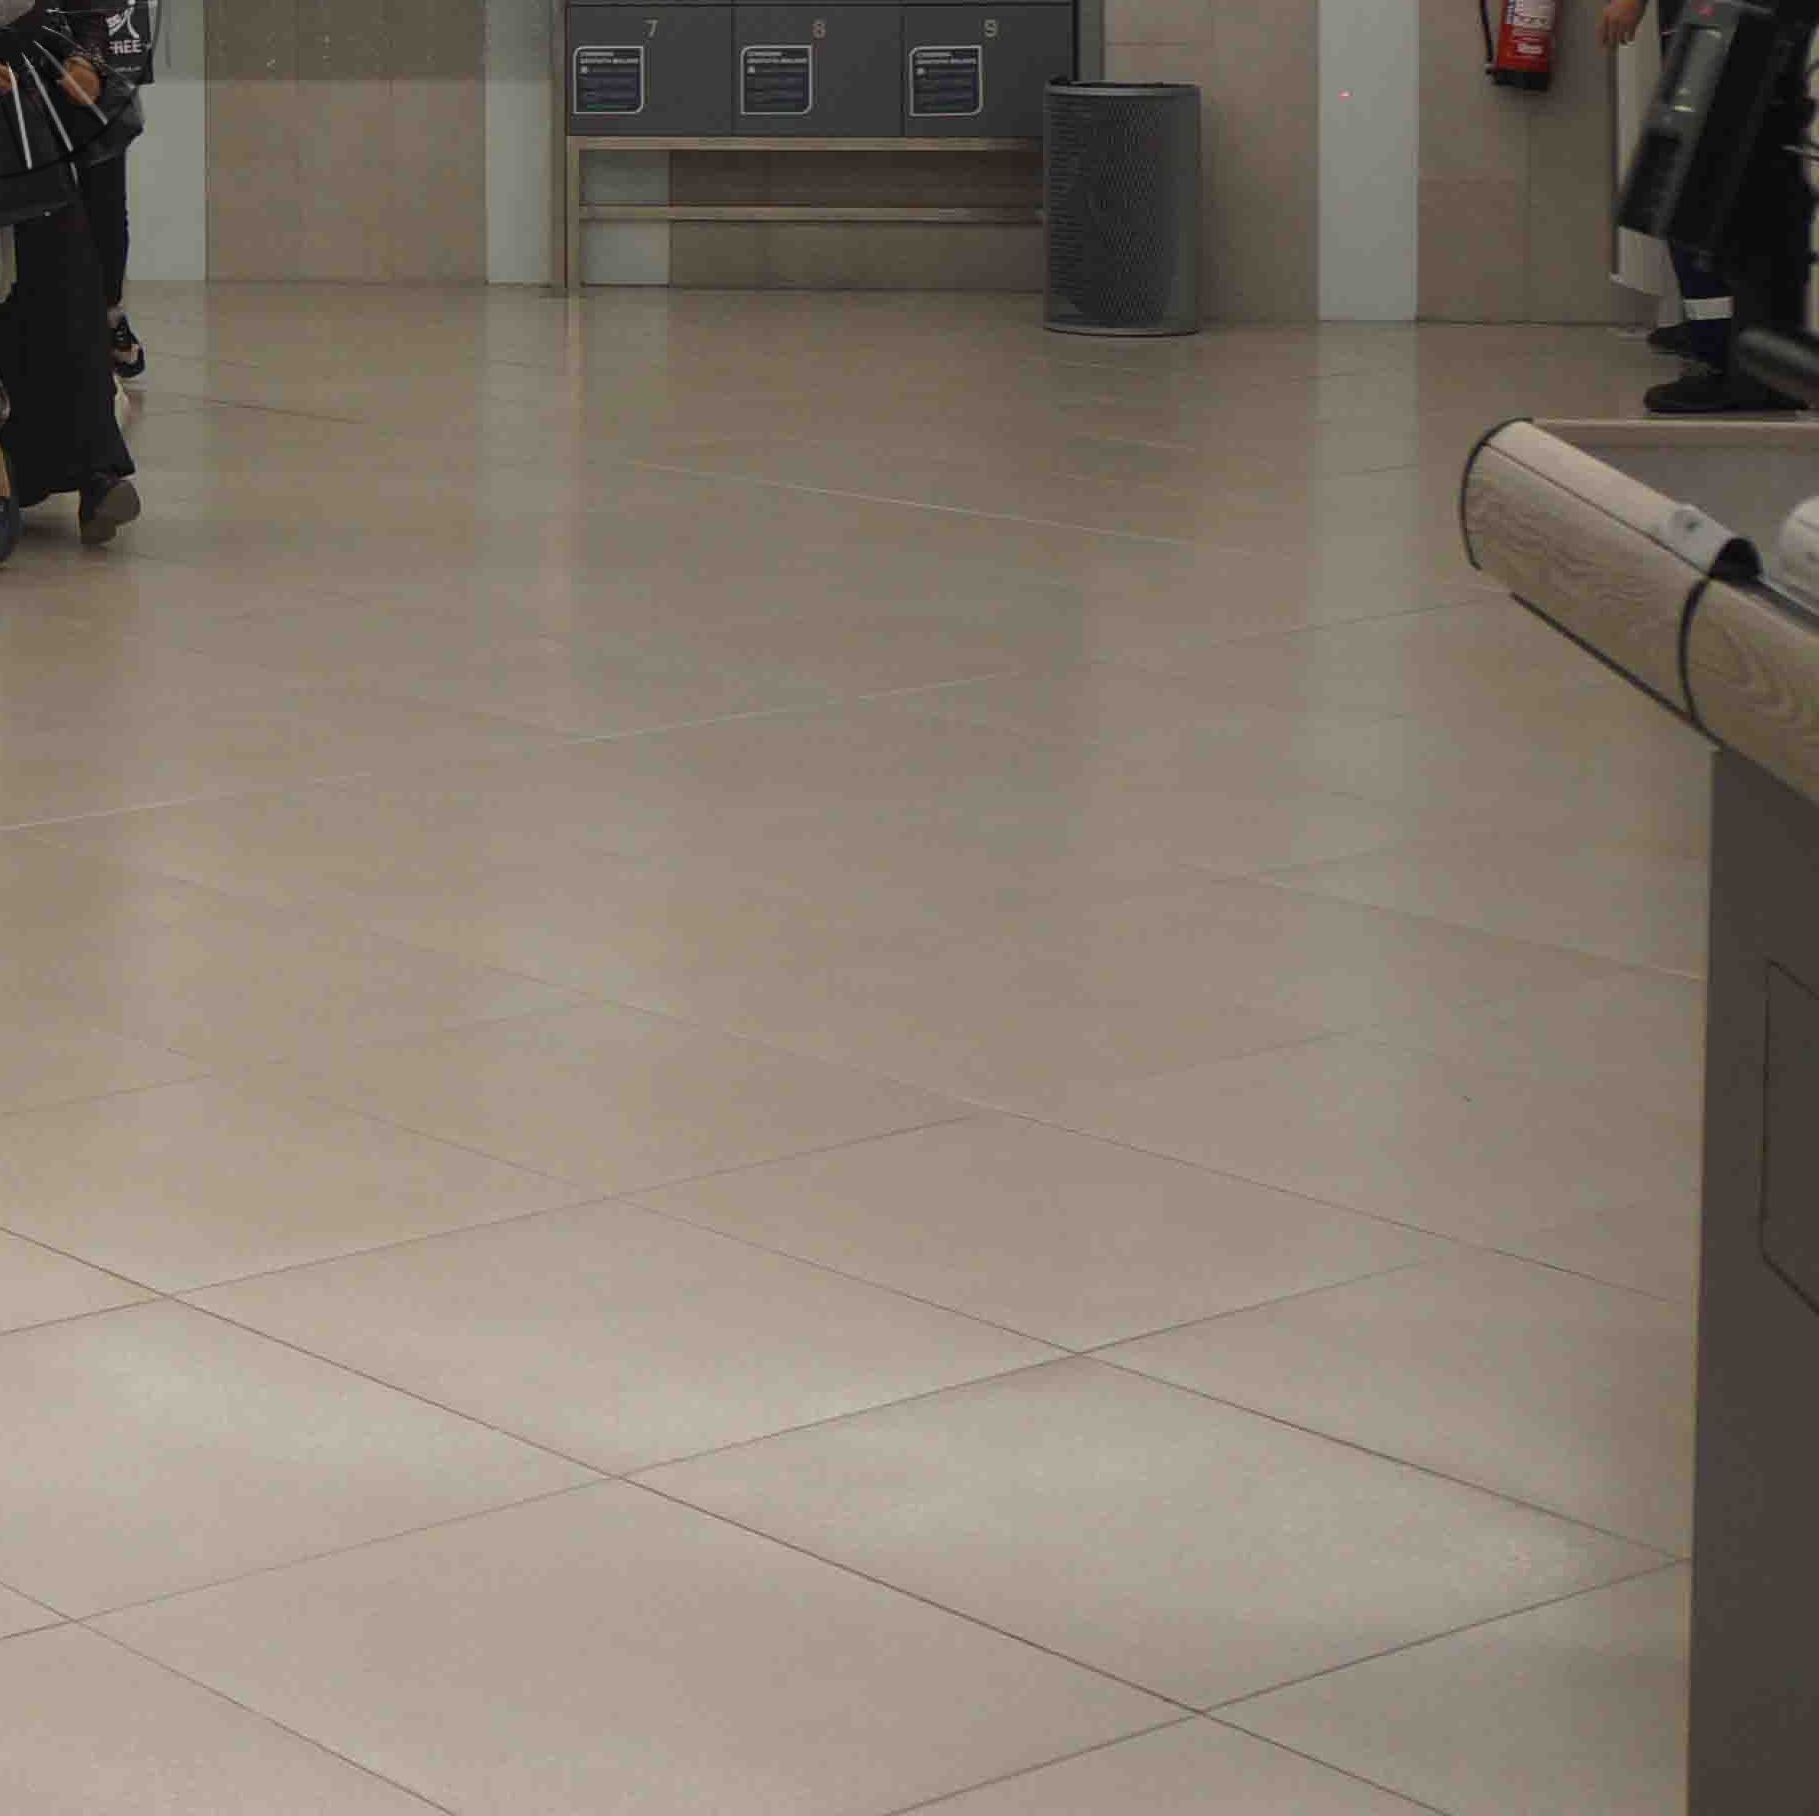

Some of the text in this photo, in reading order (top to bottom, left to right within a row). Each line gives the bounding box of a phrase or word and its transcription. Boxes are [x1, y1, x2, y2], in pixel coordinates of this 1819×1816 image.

[644, 18, 660, 38] 7
[812, 19, 826, 39] 8
[984, 19, 999, 38] 9
